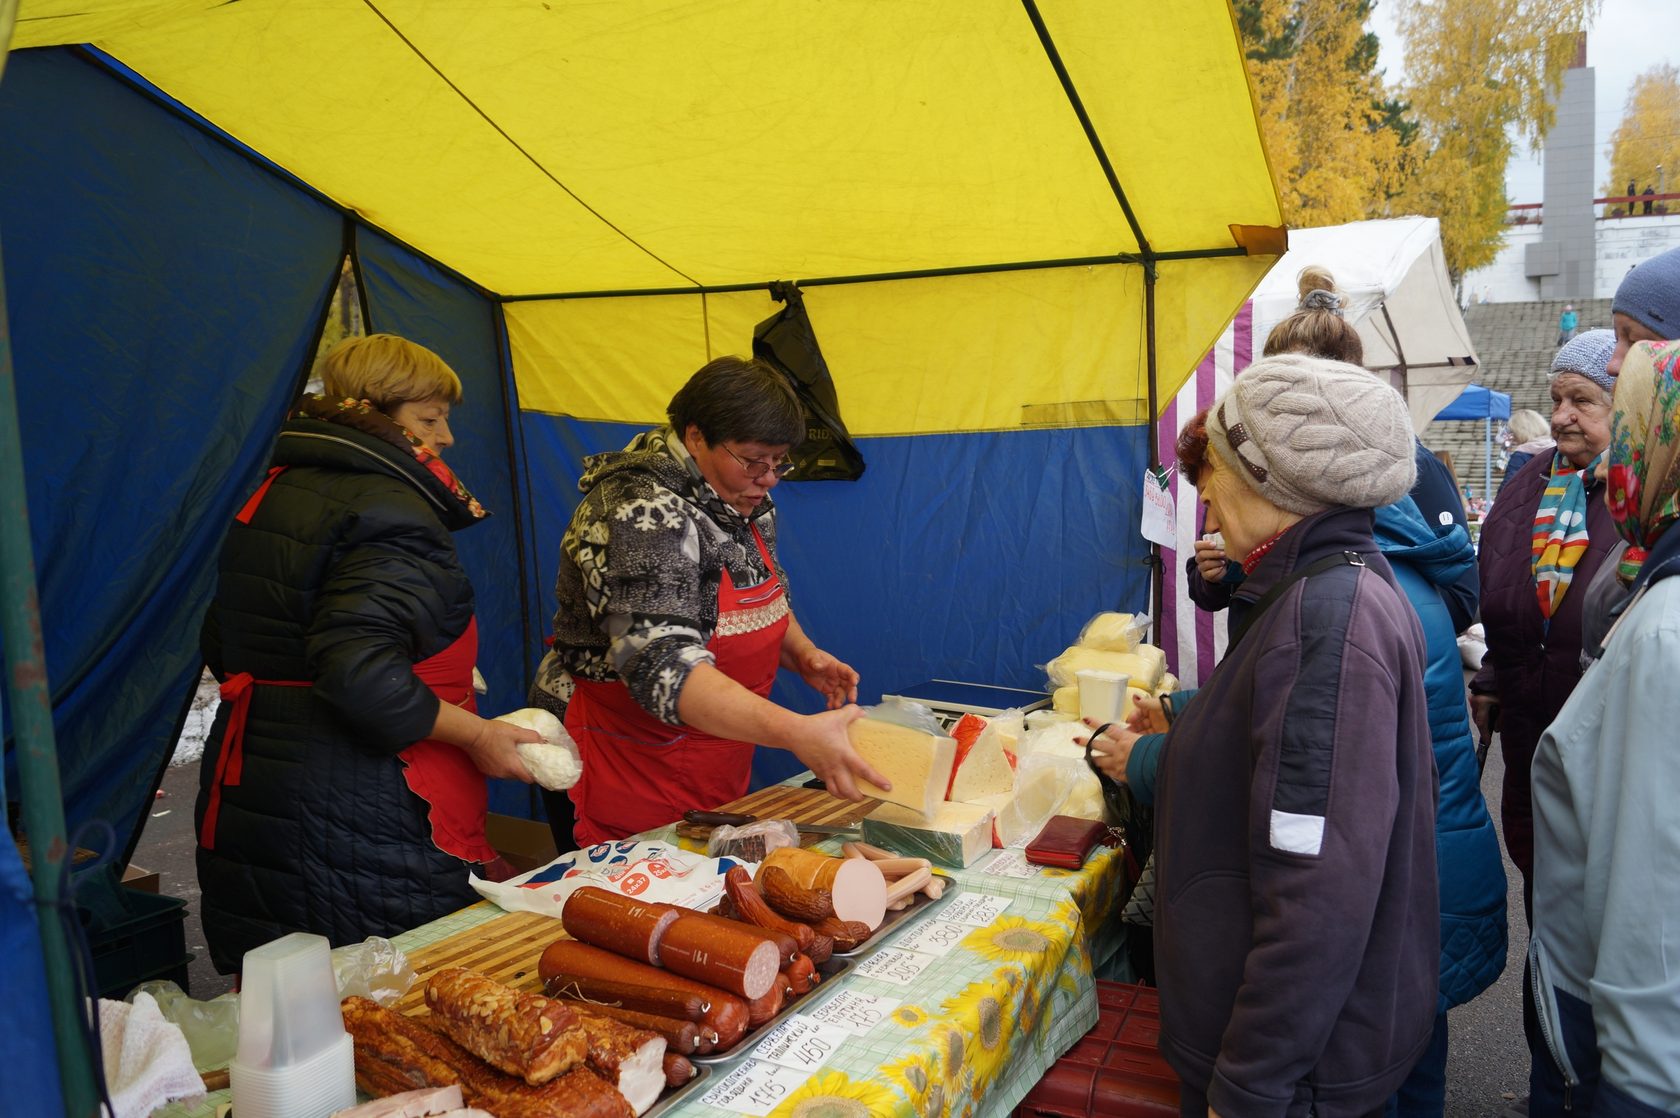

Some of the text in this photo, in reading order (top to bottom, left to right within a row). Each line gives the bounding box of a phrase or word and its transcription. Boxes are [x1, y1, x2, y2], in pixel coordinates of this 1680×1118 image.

[812, 990, 852, 1020] СЕРВЕЛАТ
[755, 1018, 793, 1055] СЕРВЕЛАТ
[793, 1036, 832, 1066] 450
[716, 1076, 753, 1107] ГОВЯДИНА
